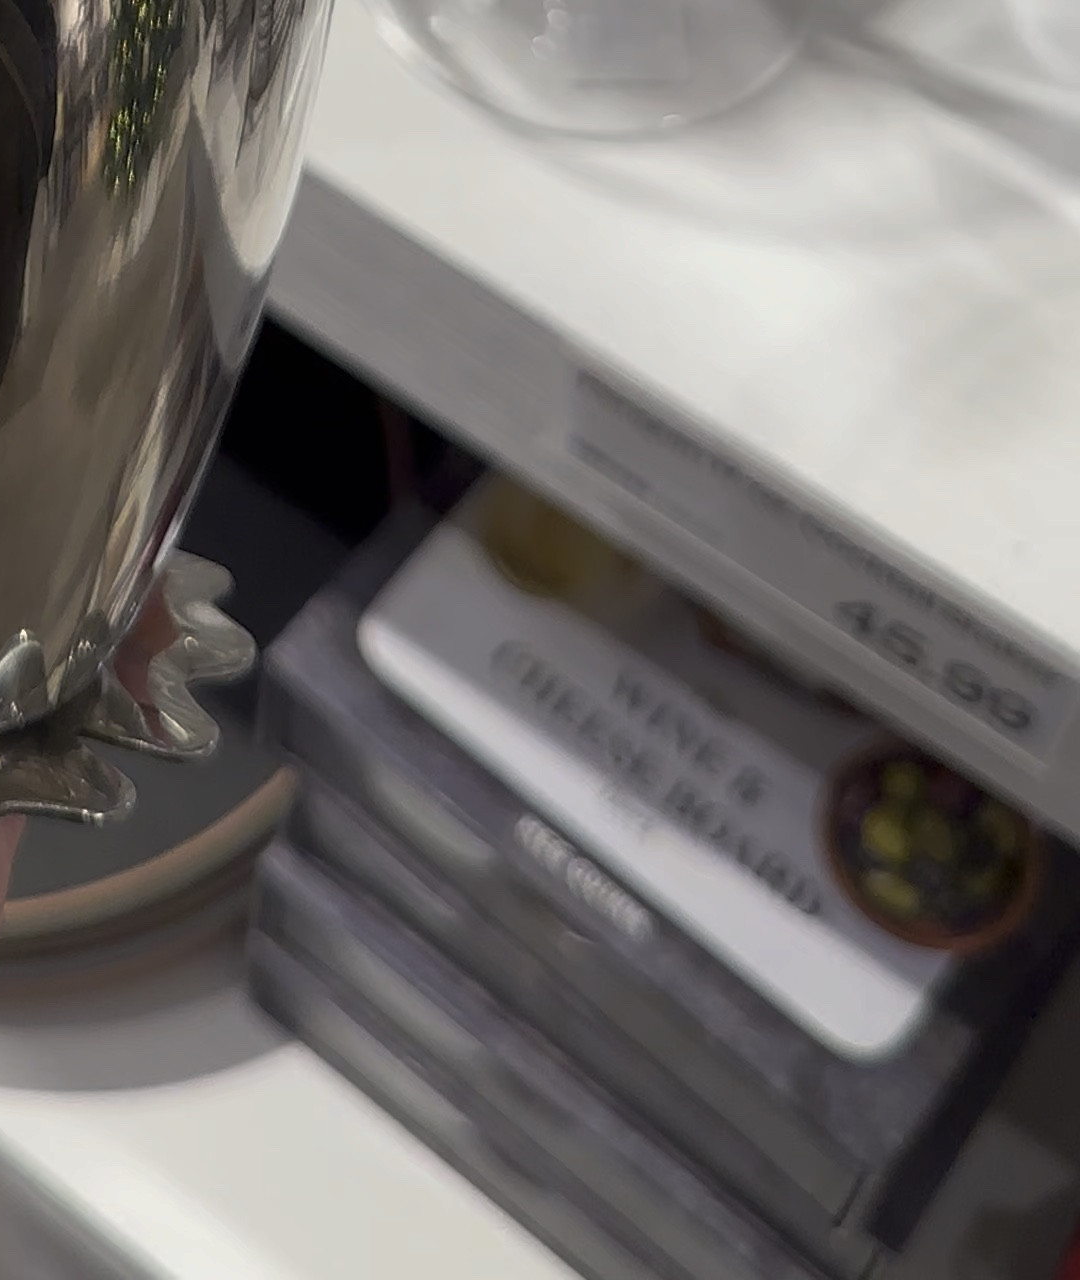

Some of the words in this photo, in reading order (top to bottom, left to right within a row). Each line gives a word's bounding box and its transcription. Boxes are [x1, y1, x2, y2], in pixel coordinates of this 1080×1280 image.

[488, 638, 662, 792] CHEESE
[662, 776, 826, 918] BOARD
[610, 670, 726, 778] WINE
